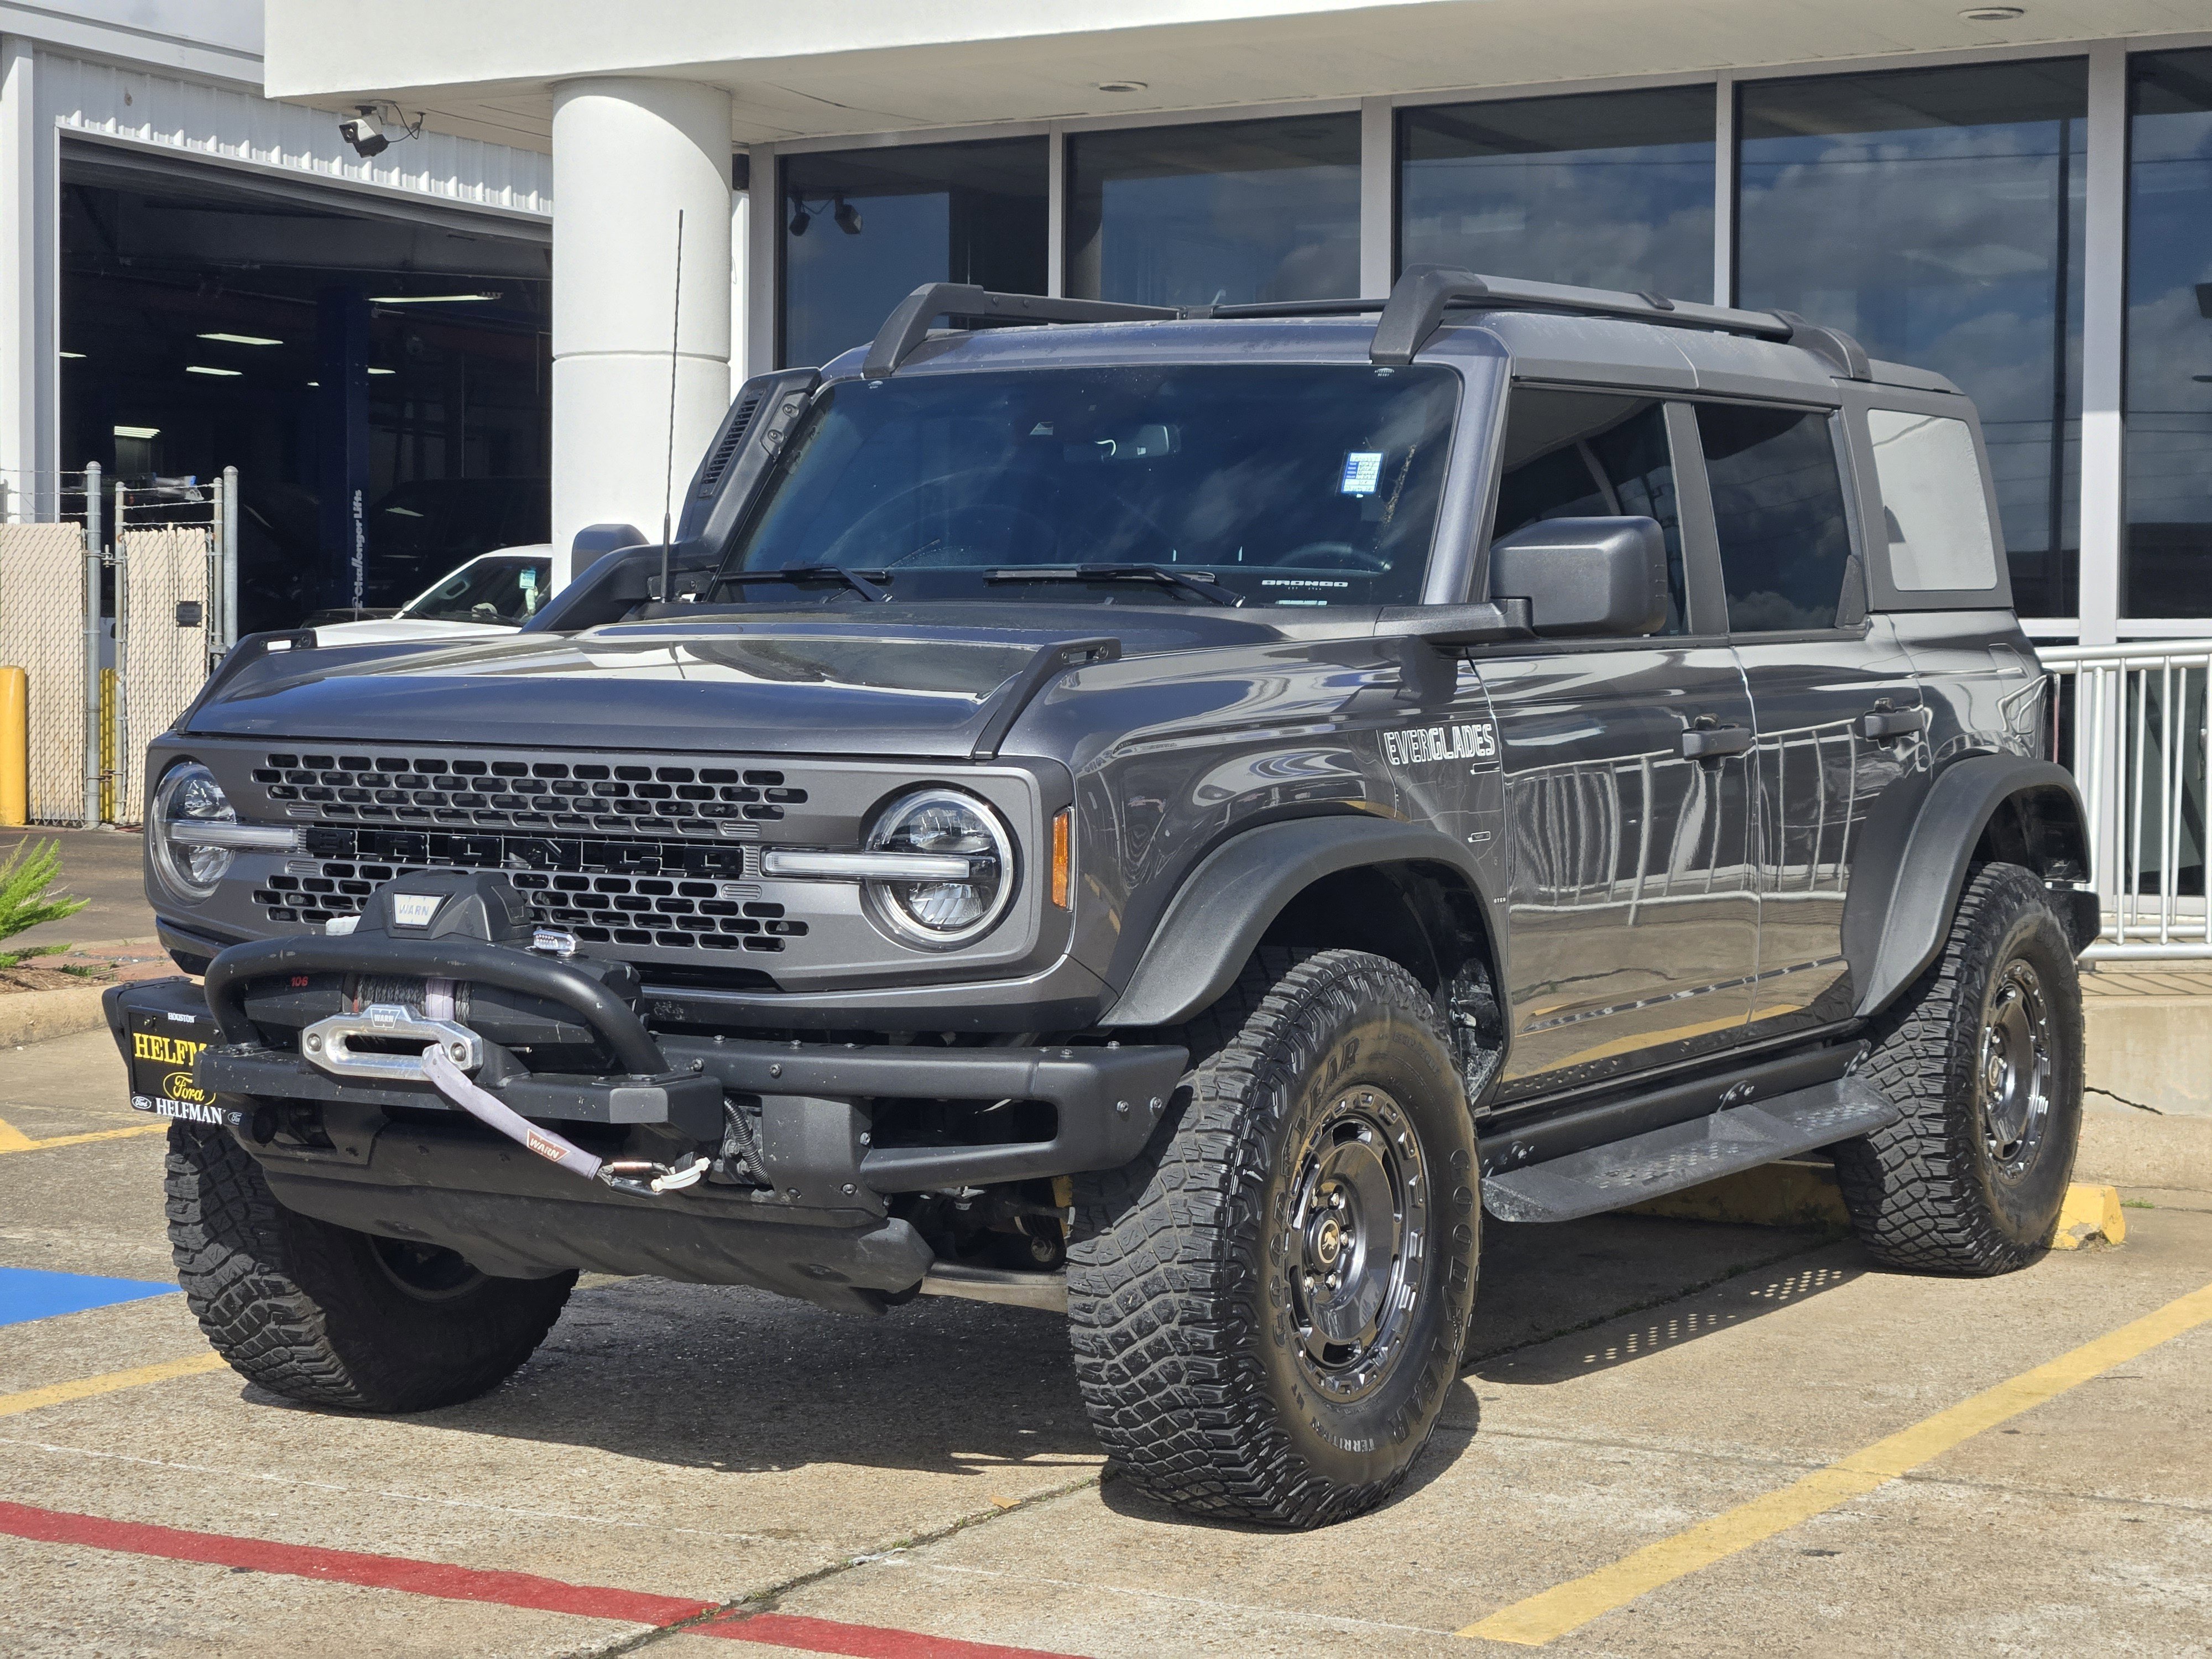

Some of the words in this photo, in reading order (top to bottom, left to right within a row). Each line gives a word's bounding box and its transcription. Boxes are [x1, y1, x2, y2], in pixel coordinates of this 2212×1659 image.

[353, 489, 363, 519] Lifts
[351, 519, 366, 596] Challenger
[1384, 723, 1495, 765] EVERGLADES
[306, 828, 744, 876] BRONCO
[399, 904, 429, 916] WARN
[291, 976, 308, 987] 106
[374, 1014, 394, 1022] WARN
[134, 1098, 149, 1108] Ford
[155, 1098, 222, 1124] HELFMAN
[530, 1138, 559, 1159] WARN
